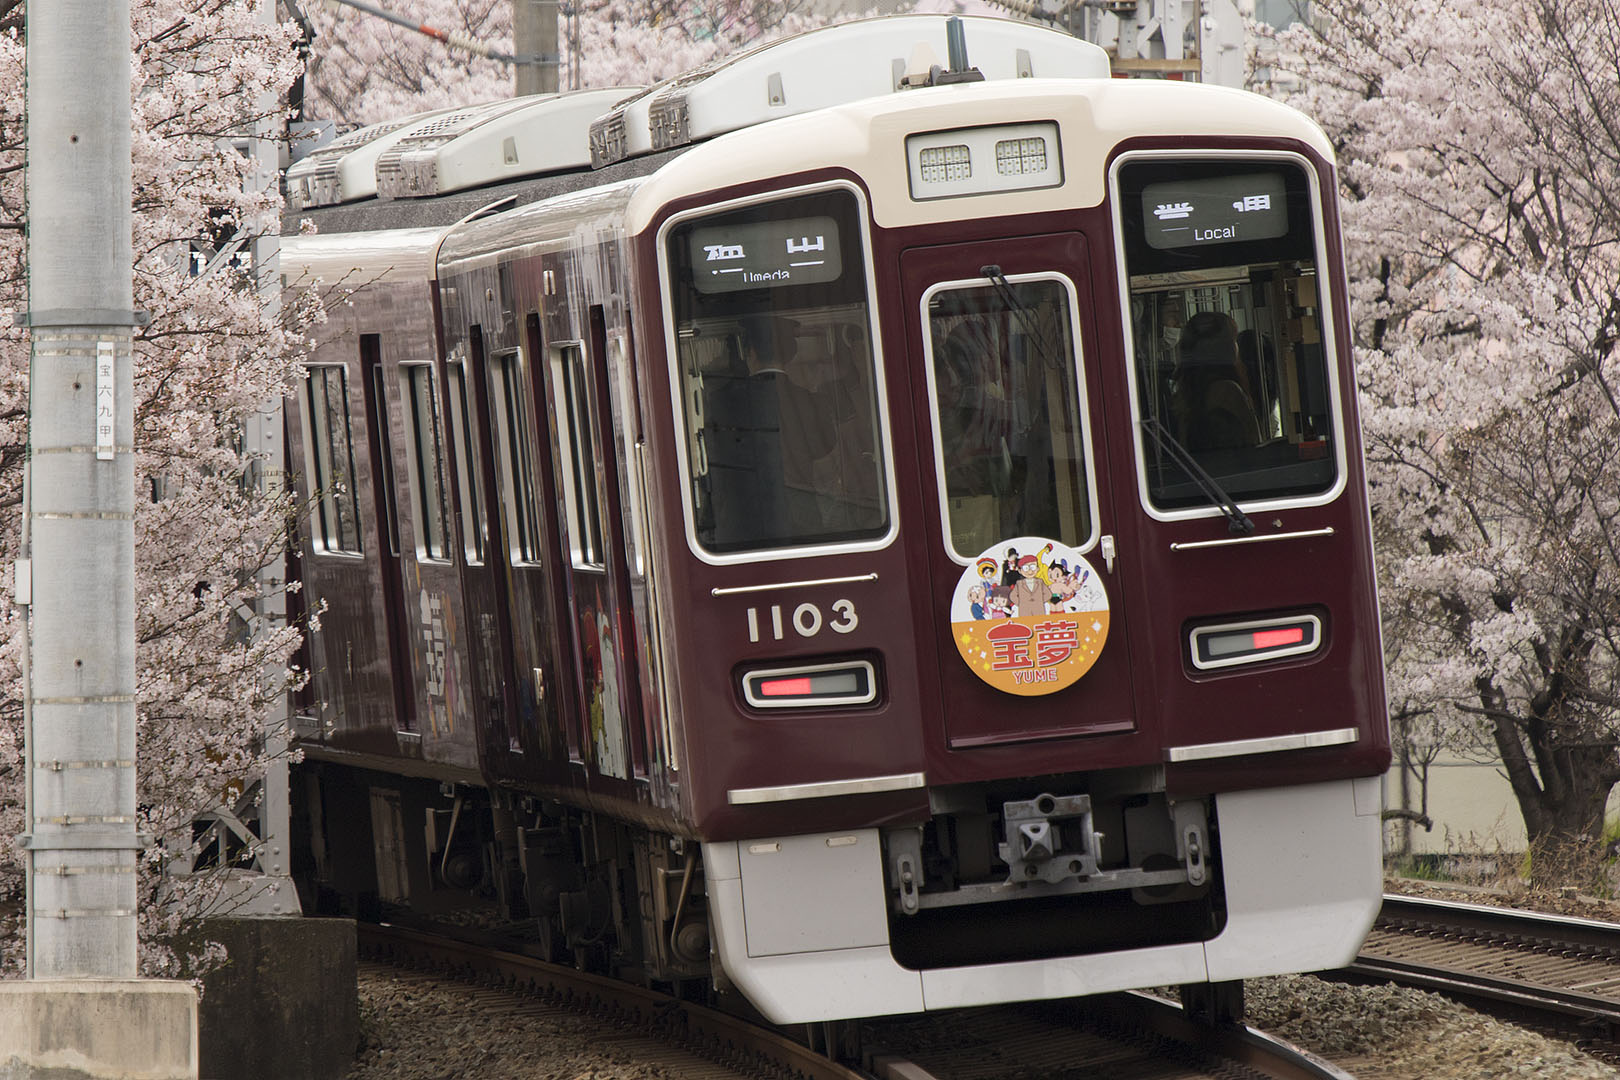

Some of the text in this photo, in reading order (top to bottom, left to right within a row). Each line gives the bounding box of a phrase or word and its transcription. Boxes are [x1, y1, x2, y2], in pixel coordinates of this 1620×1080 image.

[1194, 225, 1236, 241] Local
[98, 364, 113, 438] 宝六九甲
[747, 599, 859, 643] 1103
[1012, 667, 1058, 684] YUME
